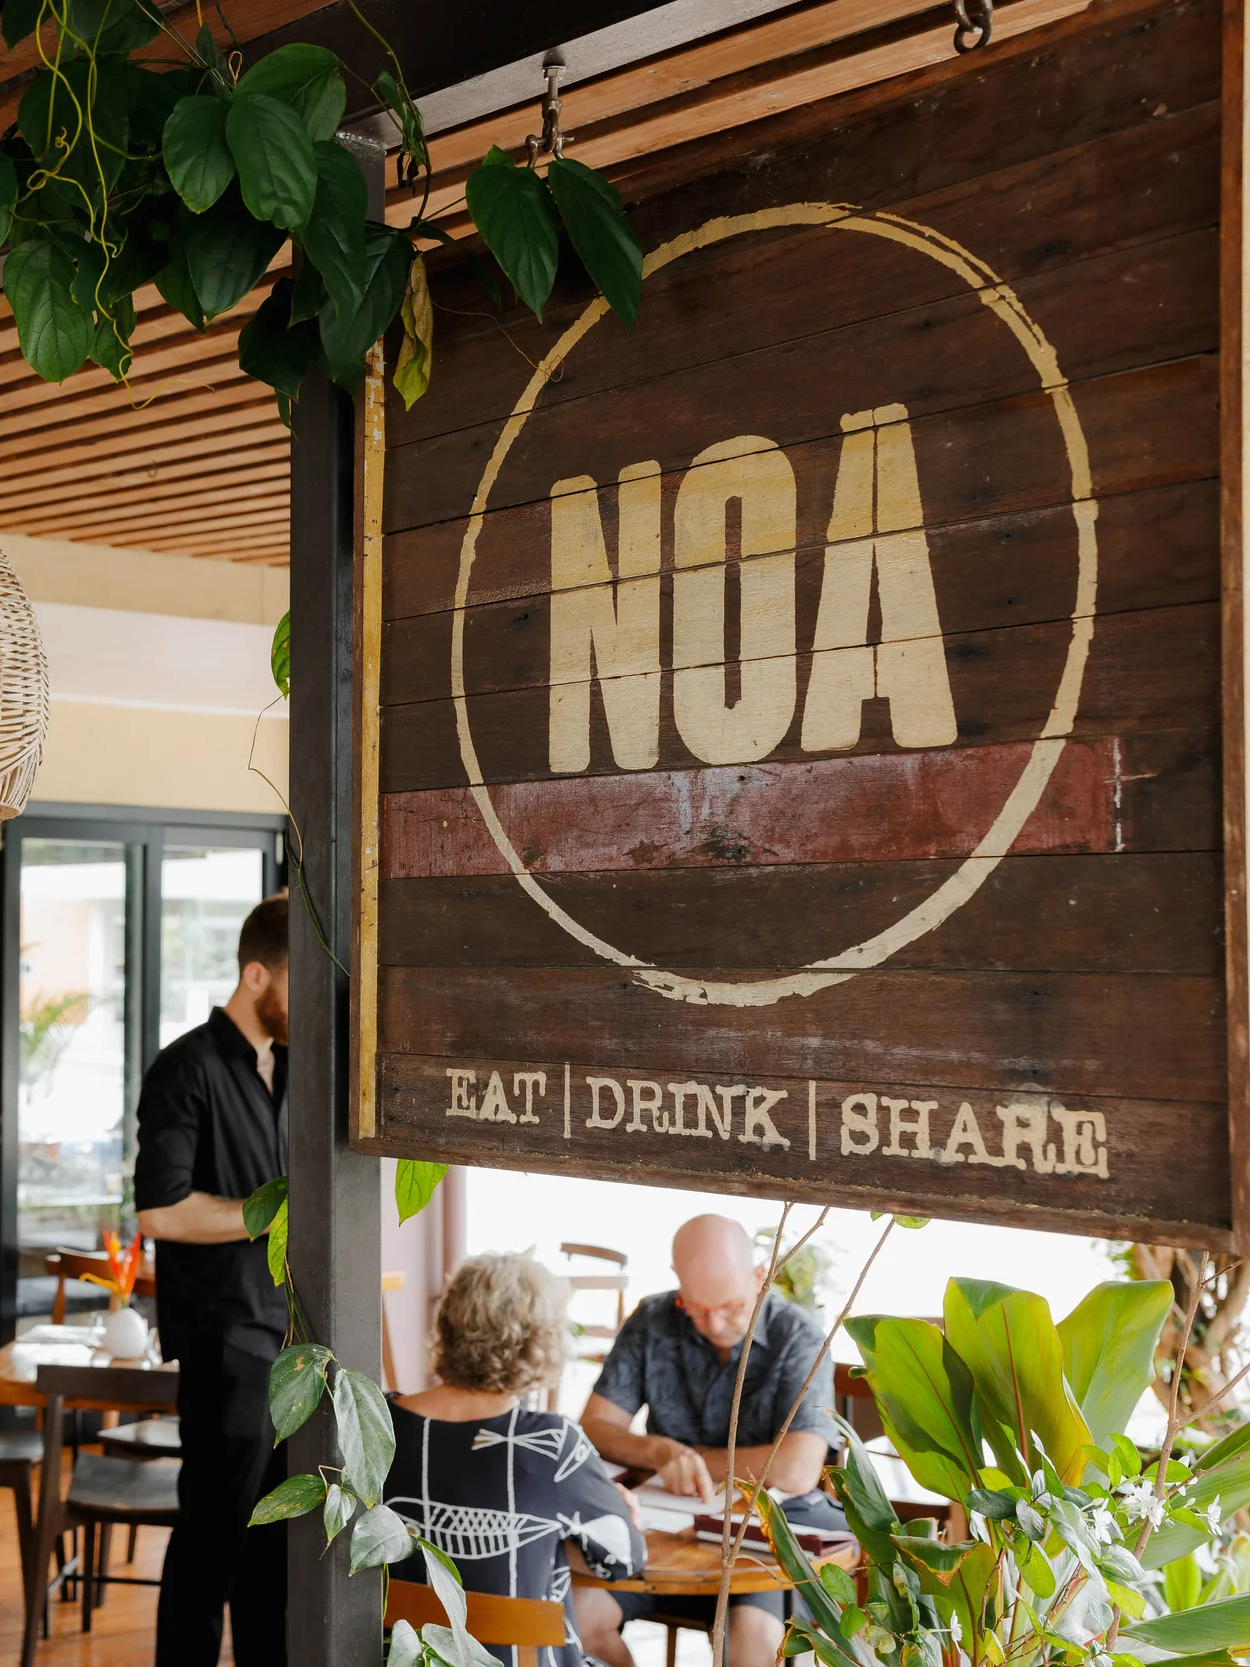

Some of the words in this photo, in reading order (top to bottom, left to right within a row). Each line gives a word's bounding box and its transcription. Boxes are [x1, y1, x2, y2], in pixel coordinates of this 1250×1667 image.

[550, 403, 957, 773] NOA
[445, 1067, 546, 1124] EAT
[585, 1075, 791, 1149] DRINK
[840, 1092, 1110, 1179] SHARE
